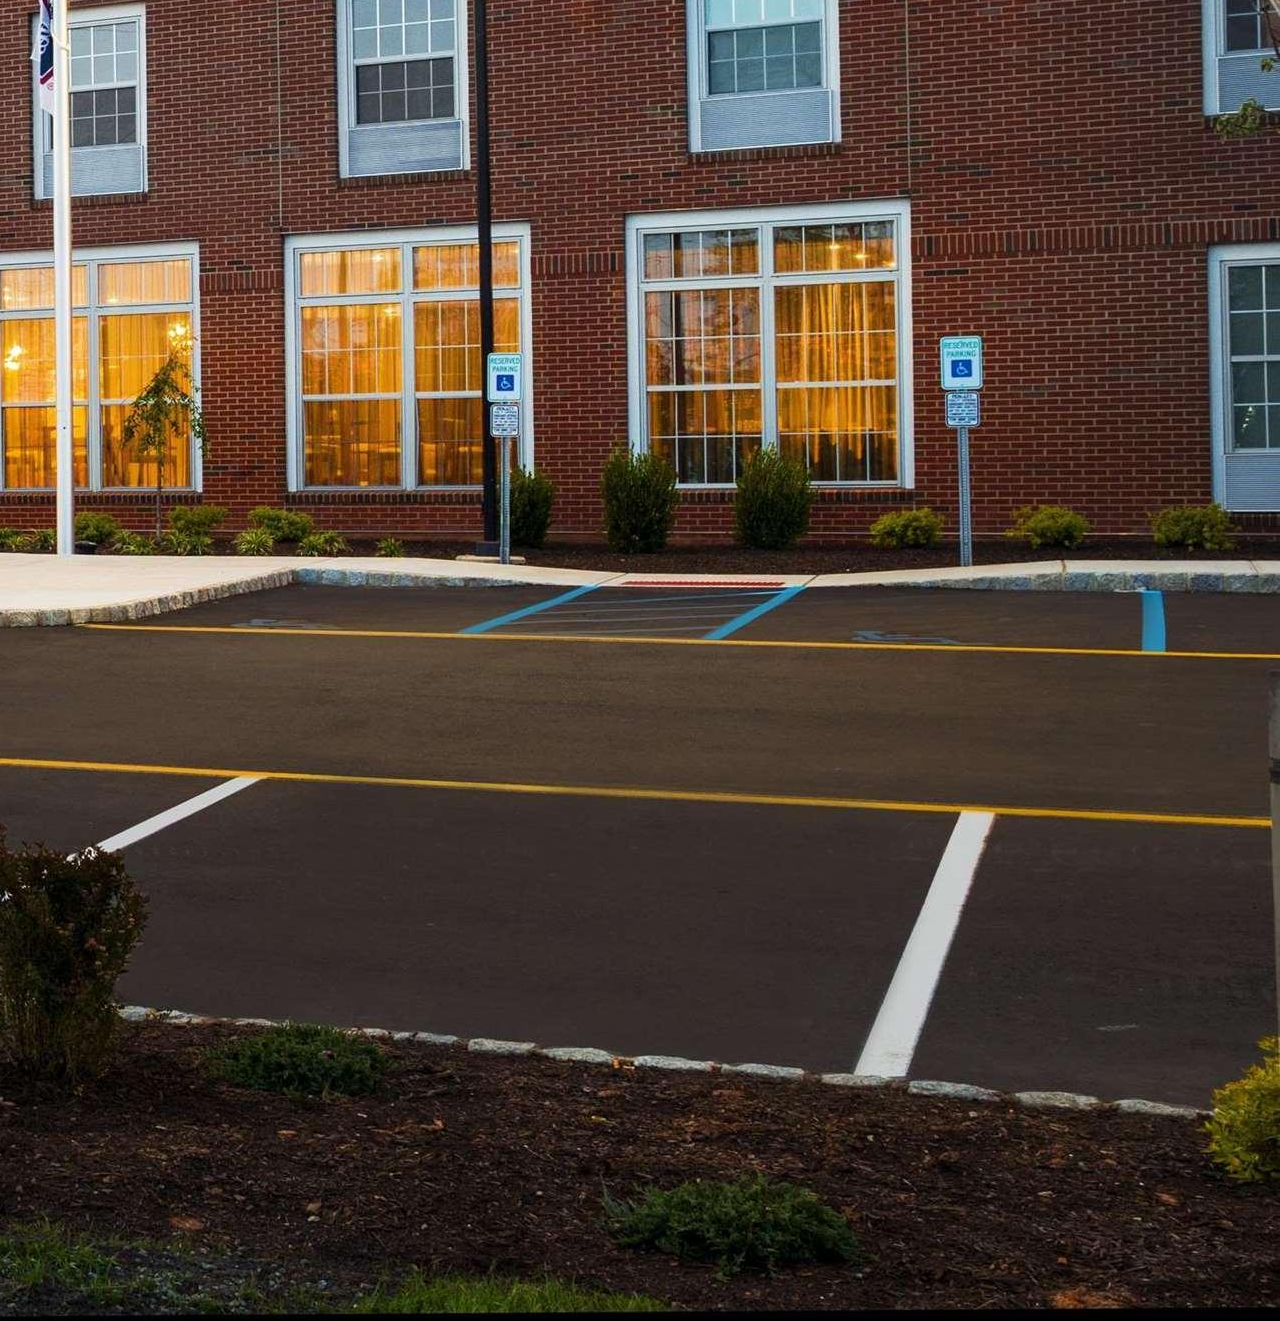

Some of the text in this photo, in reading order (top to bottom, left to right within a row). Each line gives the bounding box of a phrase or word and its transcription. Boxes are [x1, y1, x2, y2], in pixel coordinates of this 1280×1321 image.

[944, 341, 978, 349] RESERVED
[946, 350, 976, 358] PARKING
[490, 357, 521, 365] RESERVED
[491, 365, 519, 373] PARKING
